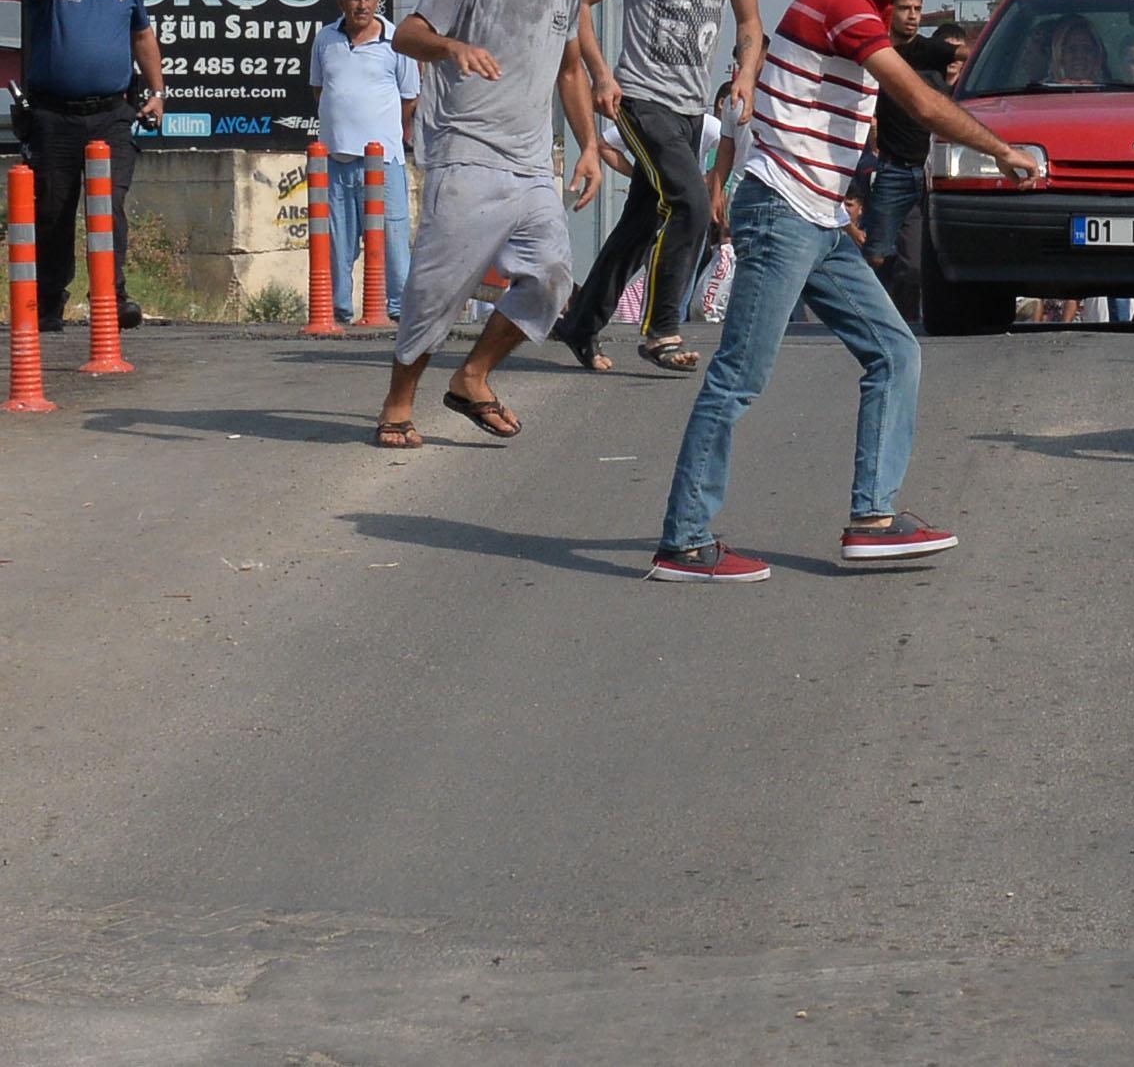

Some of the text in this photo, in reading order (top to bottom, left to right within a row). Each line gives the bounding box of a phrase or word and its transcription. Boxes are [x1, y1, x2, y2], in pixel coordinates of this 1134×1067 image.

[161, 57, 188, 75] 22
[193, 57, 235, 75] 485
[240, 57, 268, 75] 62
[273, 57, 301, 75] 72
[215, 116, 272, 134] AYGAZ
[294, 116, 320, 129] falc
[1087, 219, 1111, 243] 01
